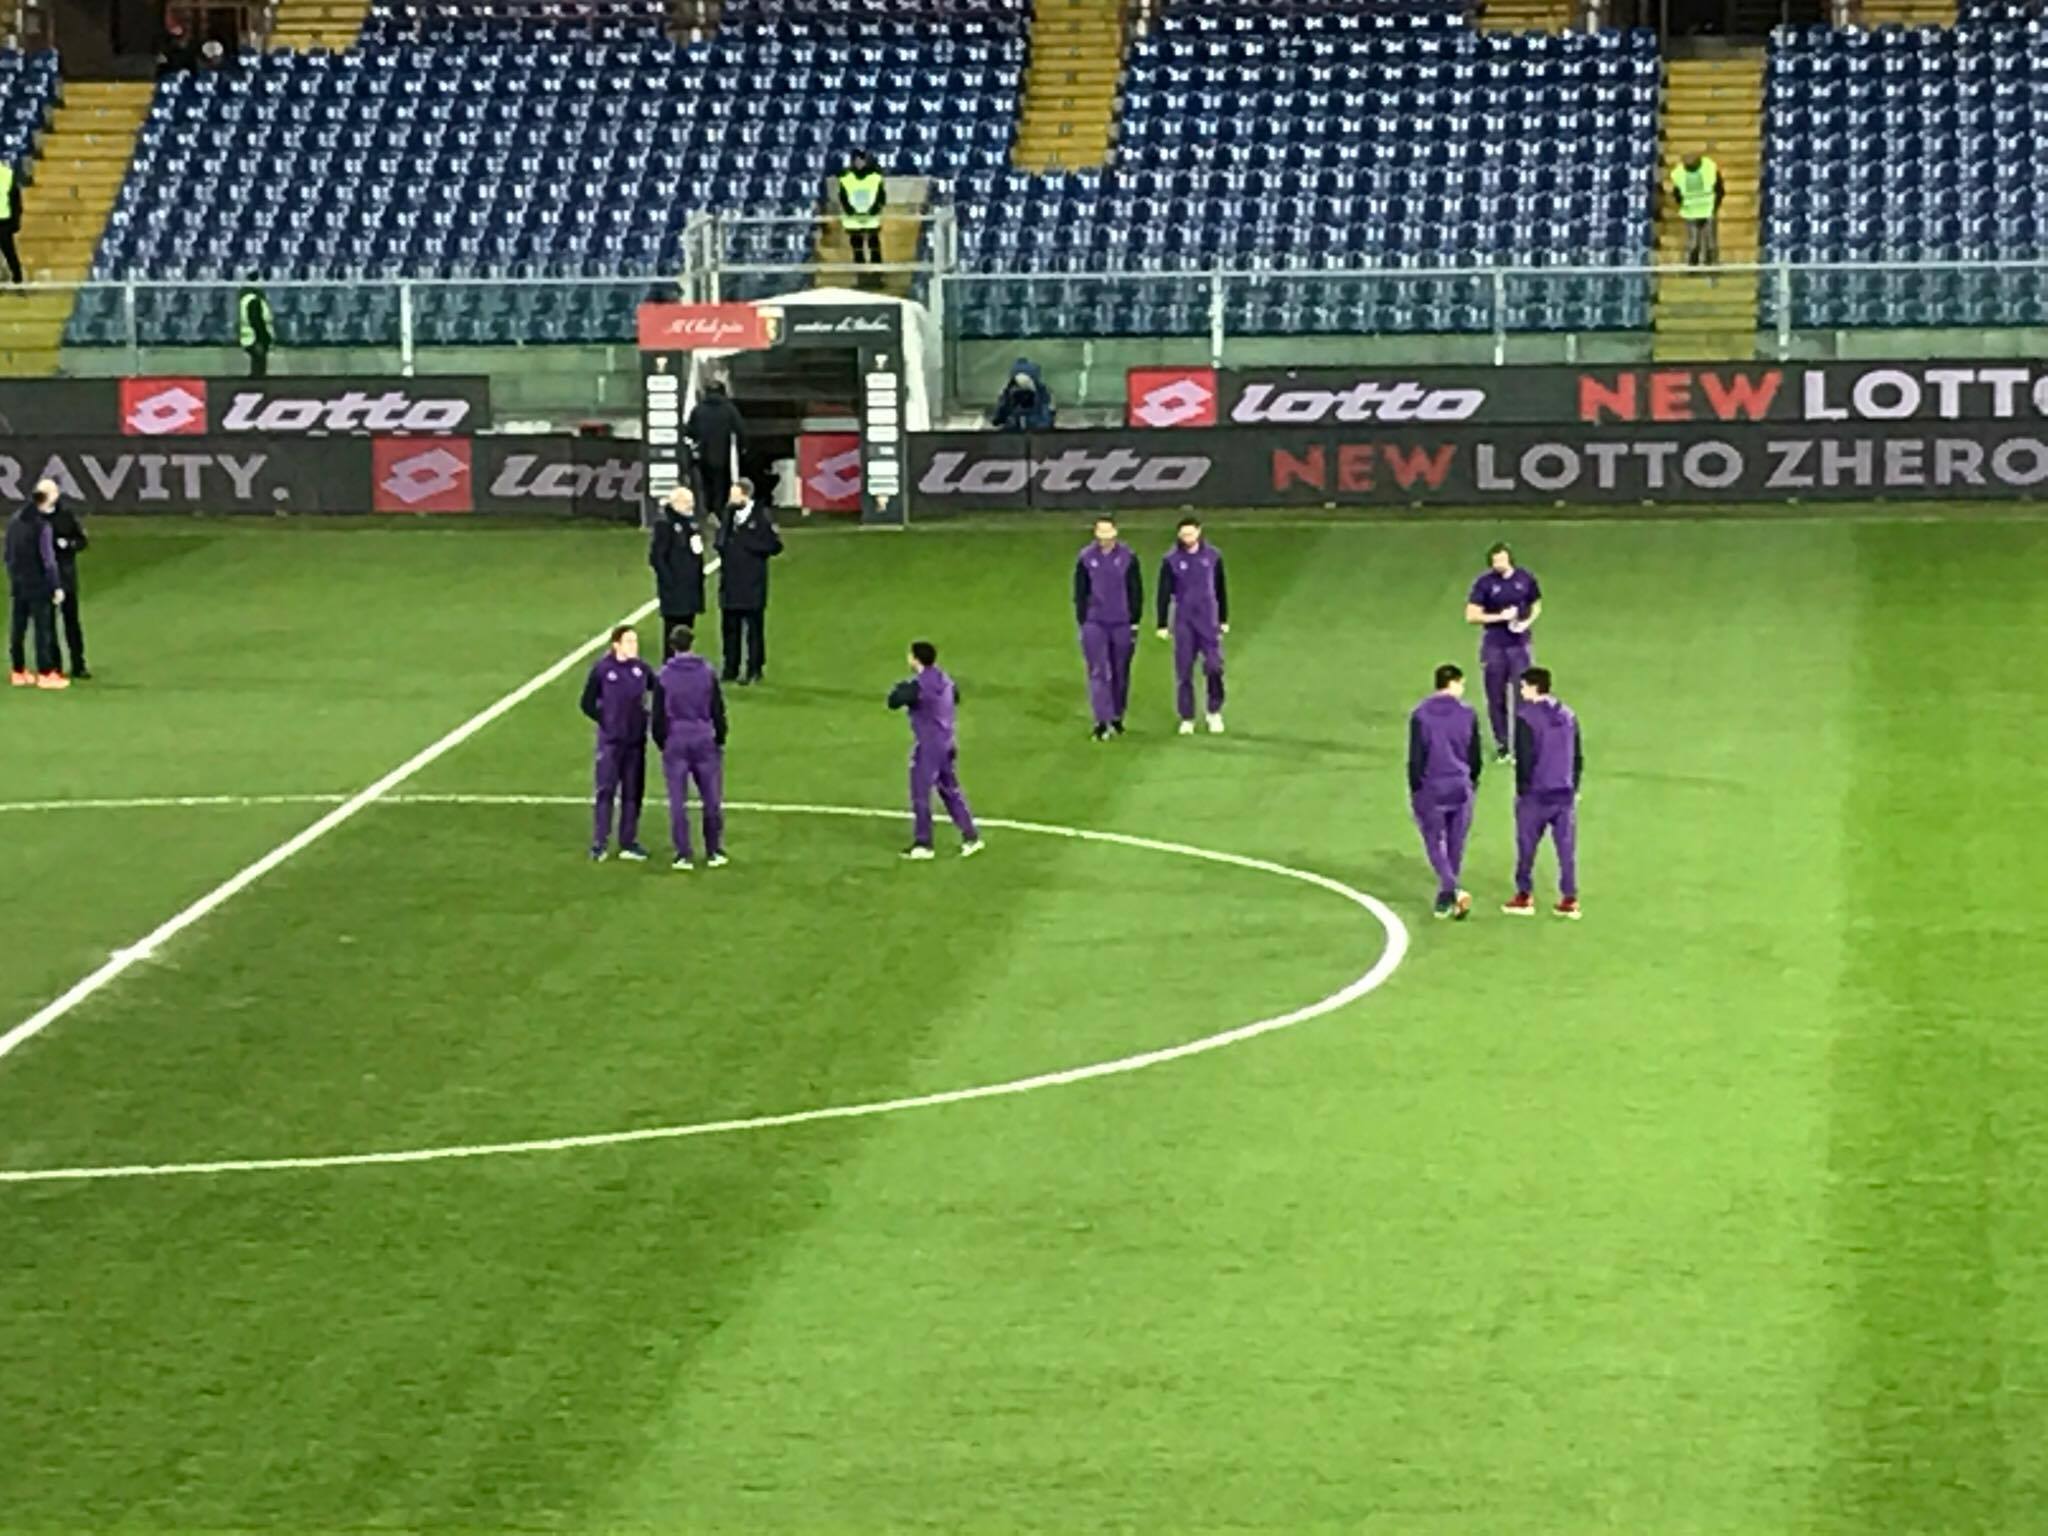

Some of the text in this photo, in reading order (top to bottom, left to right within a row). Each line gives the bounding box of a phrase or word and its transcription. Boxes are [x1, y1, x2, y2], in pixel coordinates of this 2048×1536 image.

[1578, 368, 2048, 421] NEW LOTT
[1271, 438, 2048, 491] NEW LOTTO ZHERO
